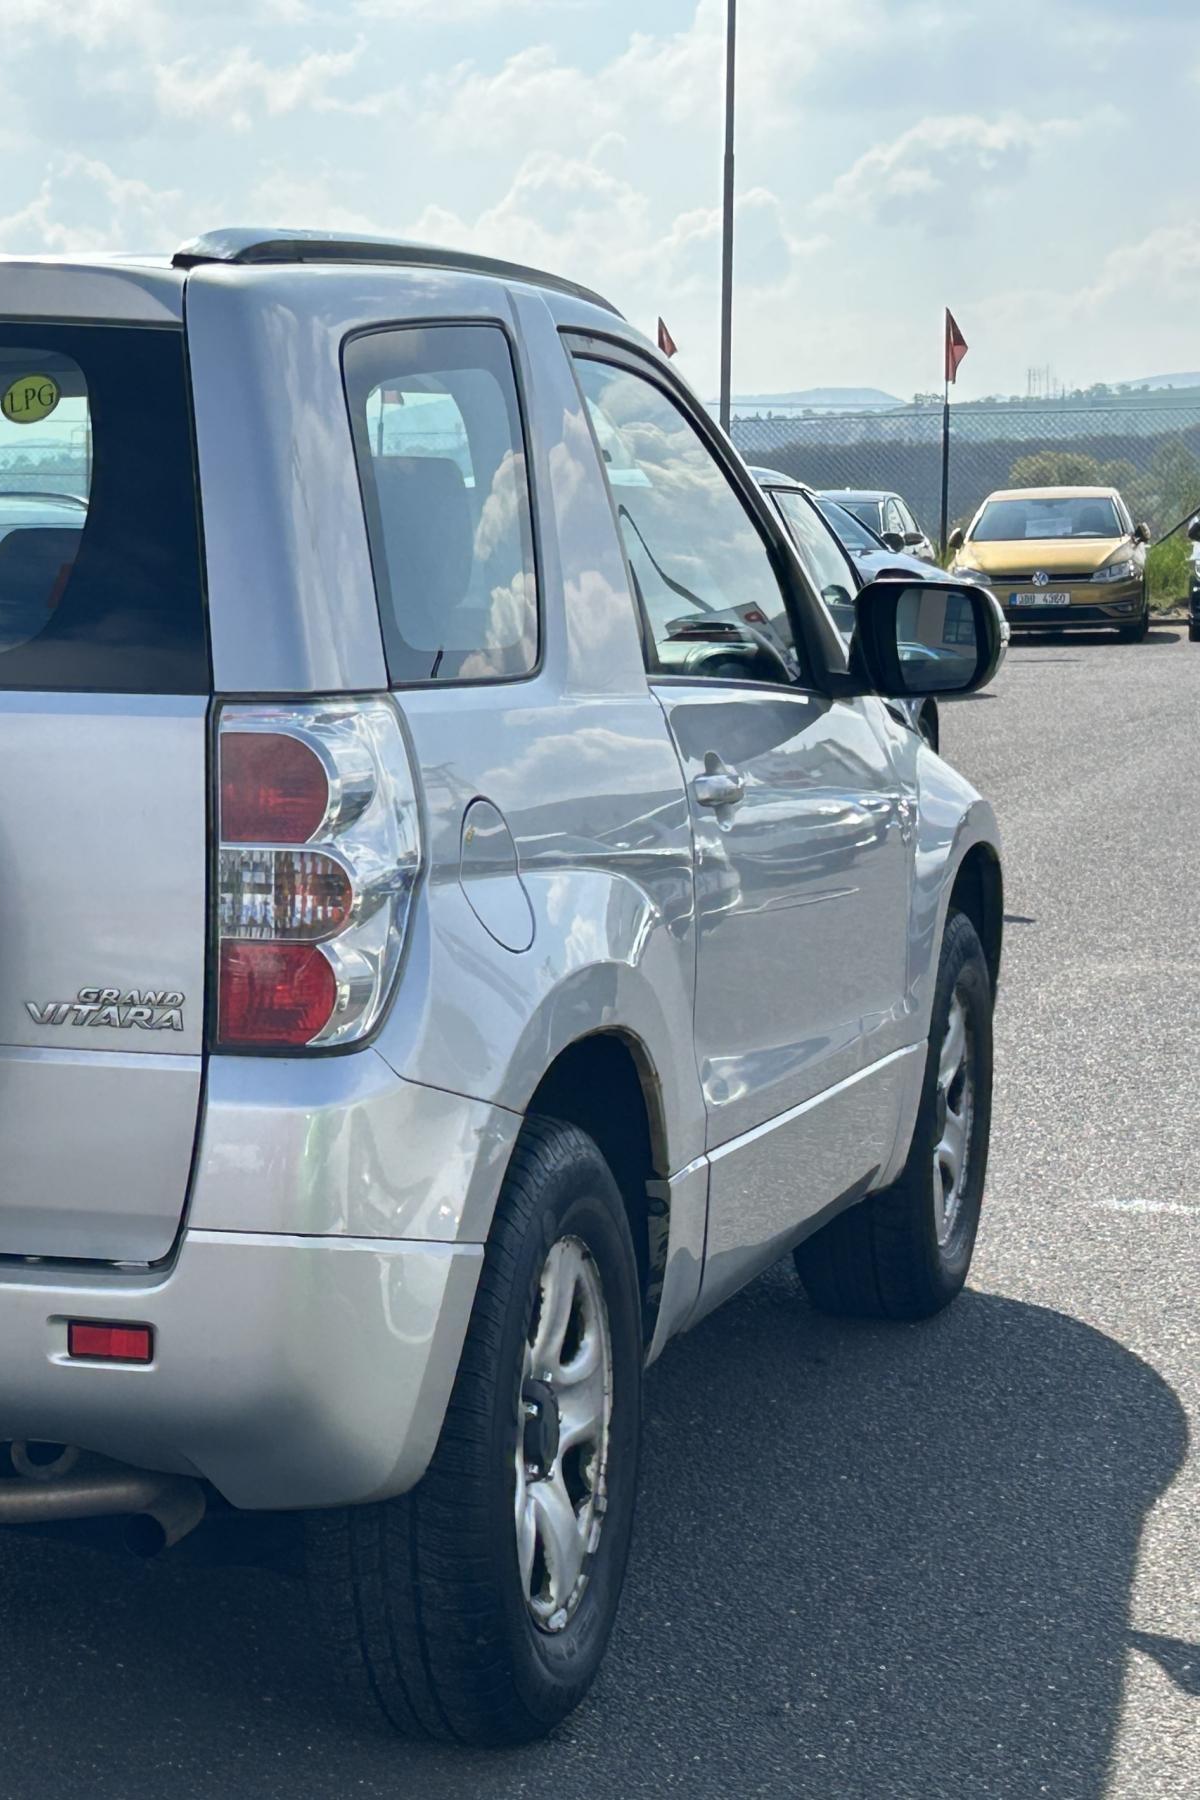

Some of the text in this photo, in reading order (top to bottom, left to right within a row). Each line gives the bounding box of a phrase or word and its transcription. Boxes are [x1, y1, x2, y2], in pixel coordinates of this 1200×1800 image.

[8, 383, 55, 413] LPG
[77, 986, 186, 1008] GRAND
[24, 1002, 185, 1032] VITARA
